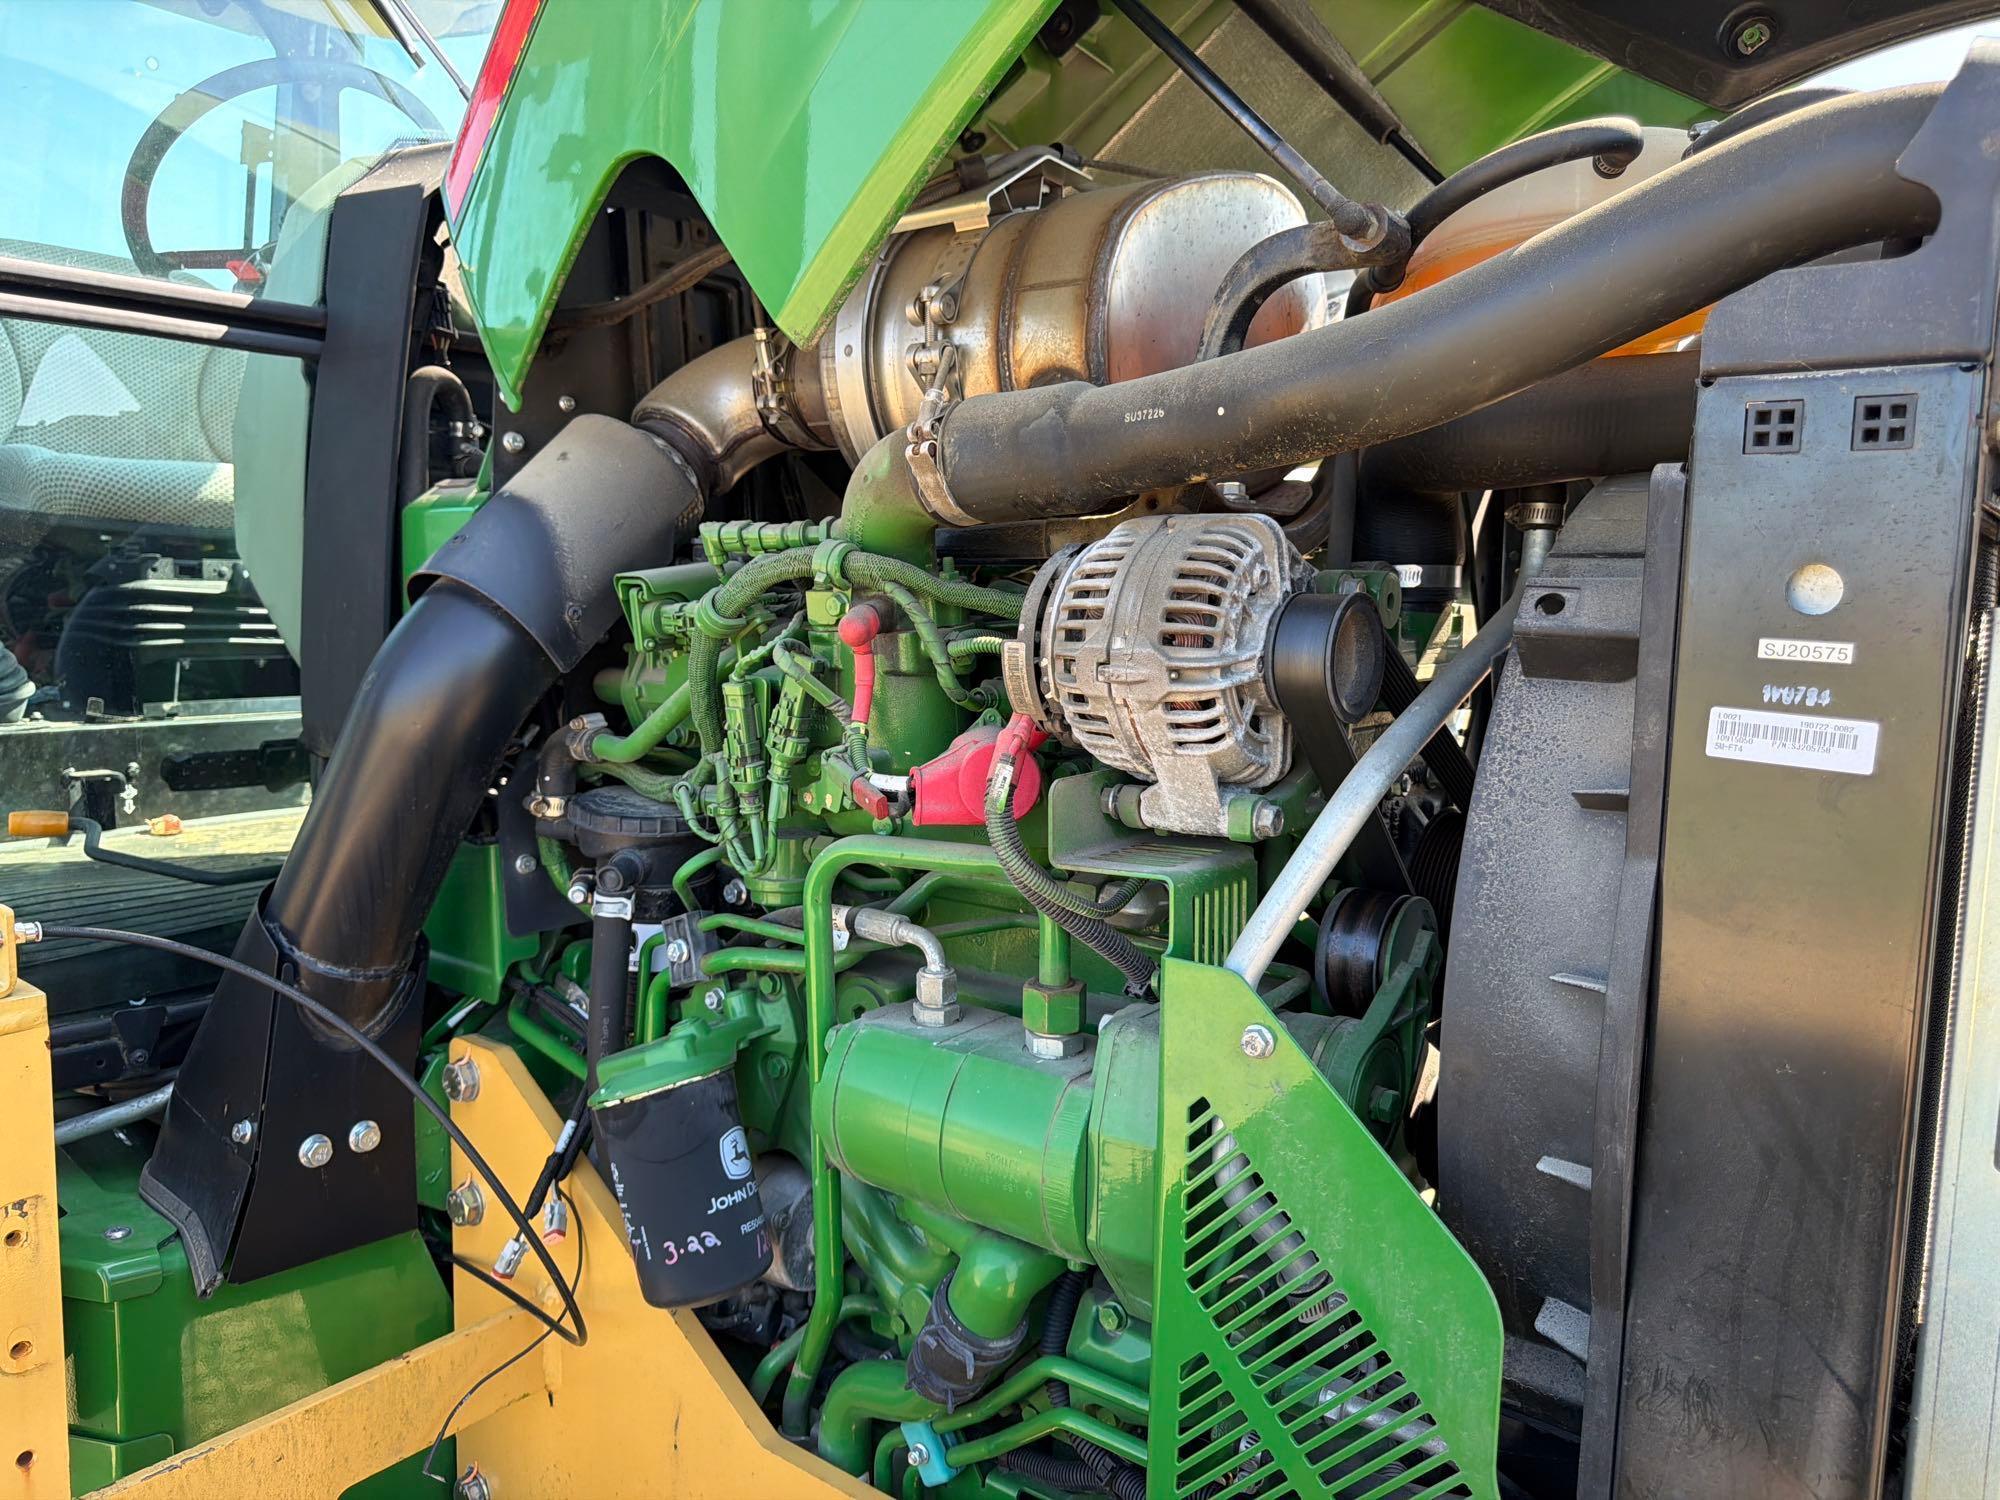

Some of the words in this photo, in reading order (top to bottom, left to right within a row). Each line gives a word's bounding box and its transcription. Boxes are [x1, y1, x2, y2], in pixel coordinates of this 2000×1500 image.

[1124, 408, 1164, 423] SU37226
[1763, 642, 1849, 662] SJ20575
[706, 1187, 748, 1215] JOHN
[663, 1230, 722, 1265] 3.22
